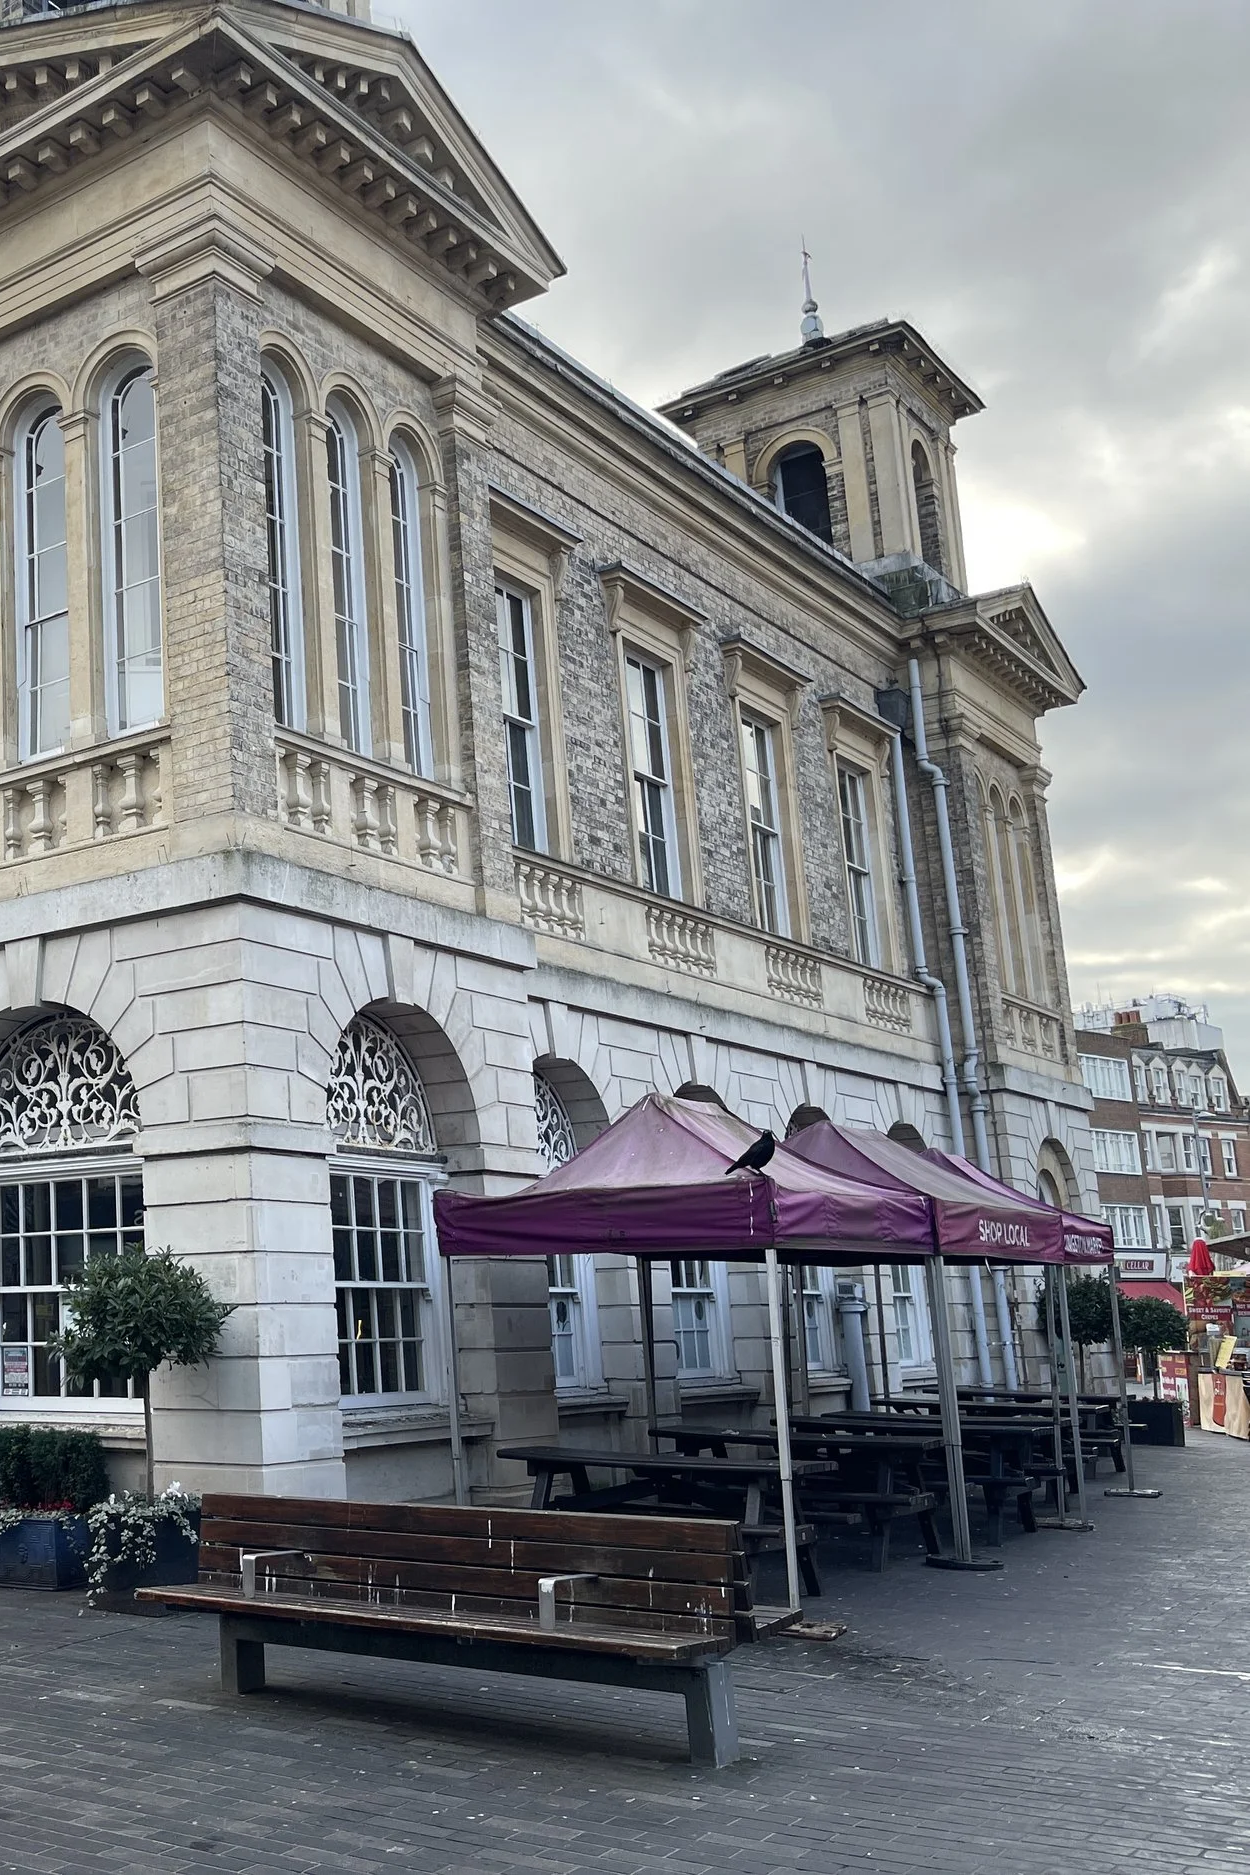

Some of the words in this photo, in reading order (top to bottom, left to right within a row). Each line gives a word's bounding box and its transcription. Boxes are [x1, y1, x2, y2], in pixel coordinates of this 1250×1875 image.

[979, 1219, 1002, 1242] SHOP
[1004, 1224, 1030, 1247] LOCAL
[1126, 1260, 1149, 1271] CELLAR
